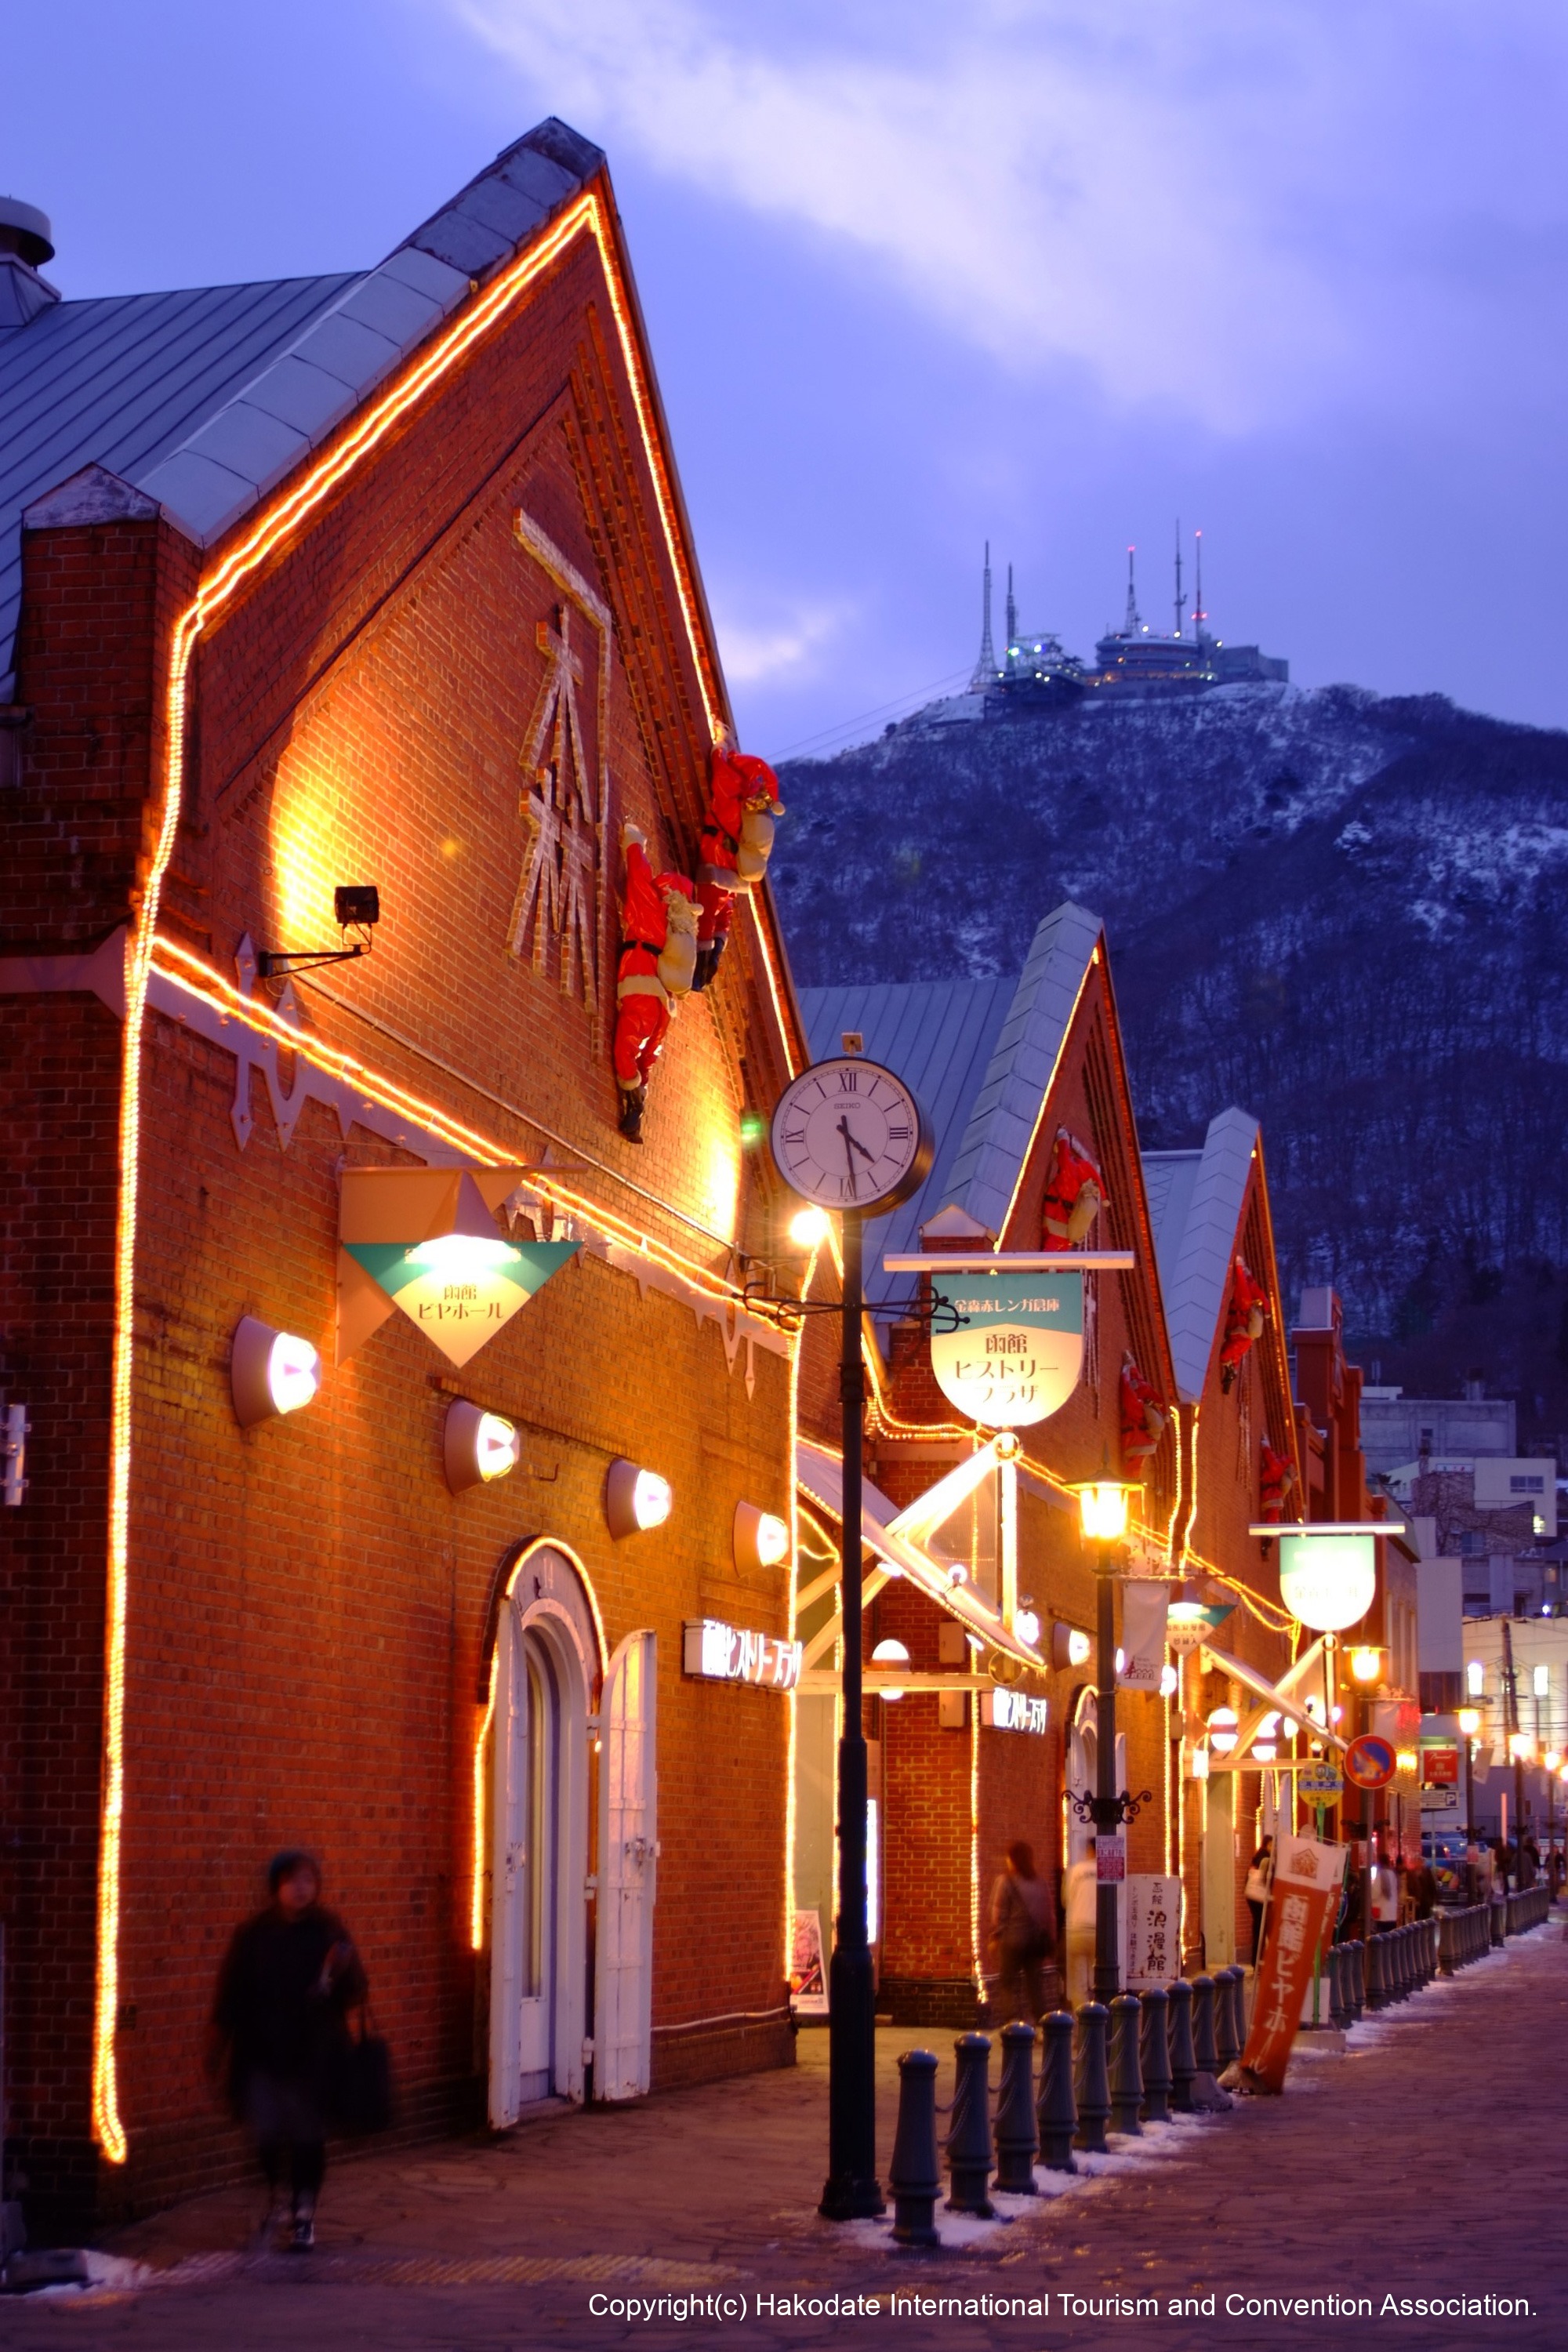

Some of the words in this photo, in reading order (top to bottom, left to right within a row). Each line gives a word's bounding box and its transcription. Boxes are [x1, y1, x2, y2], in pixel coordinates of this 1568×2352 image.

[418, 1302, 503, 1319] ビヤホール
[985, 1334, 1027, 1354] 函館
[955, 1359, 1059, 1380] ヒストリー
